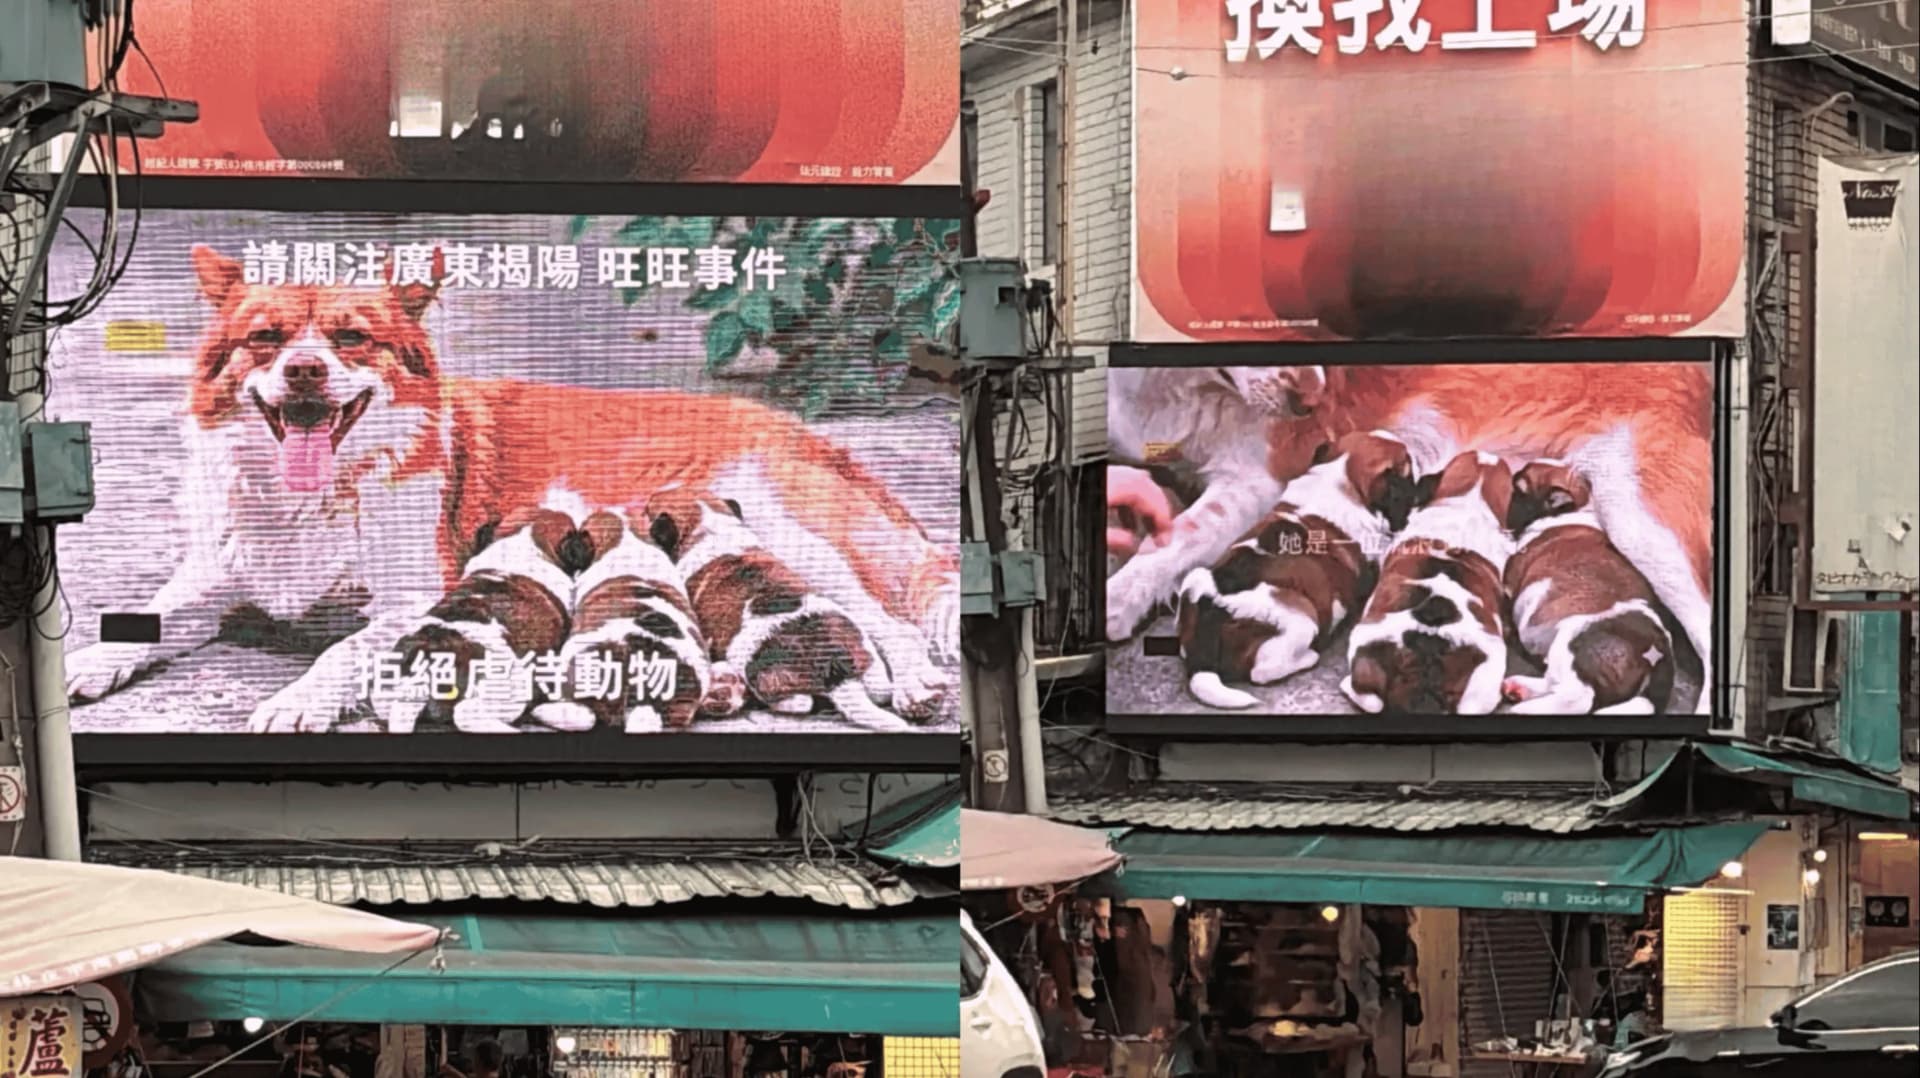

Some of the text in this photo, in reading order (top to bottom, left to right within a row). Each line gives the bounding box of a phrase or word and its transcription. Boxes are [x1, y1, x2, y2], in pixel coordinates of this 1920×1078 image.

[242, 239, 788, 291] 請關注廣東揭陽 旺旺事件
[351, 649, 678, 702] 拒絕虐待動物
